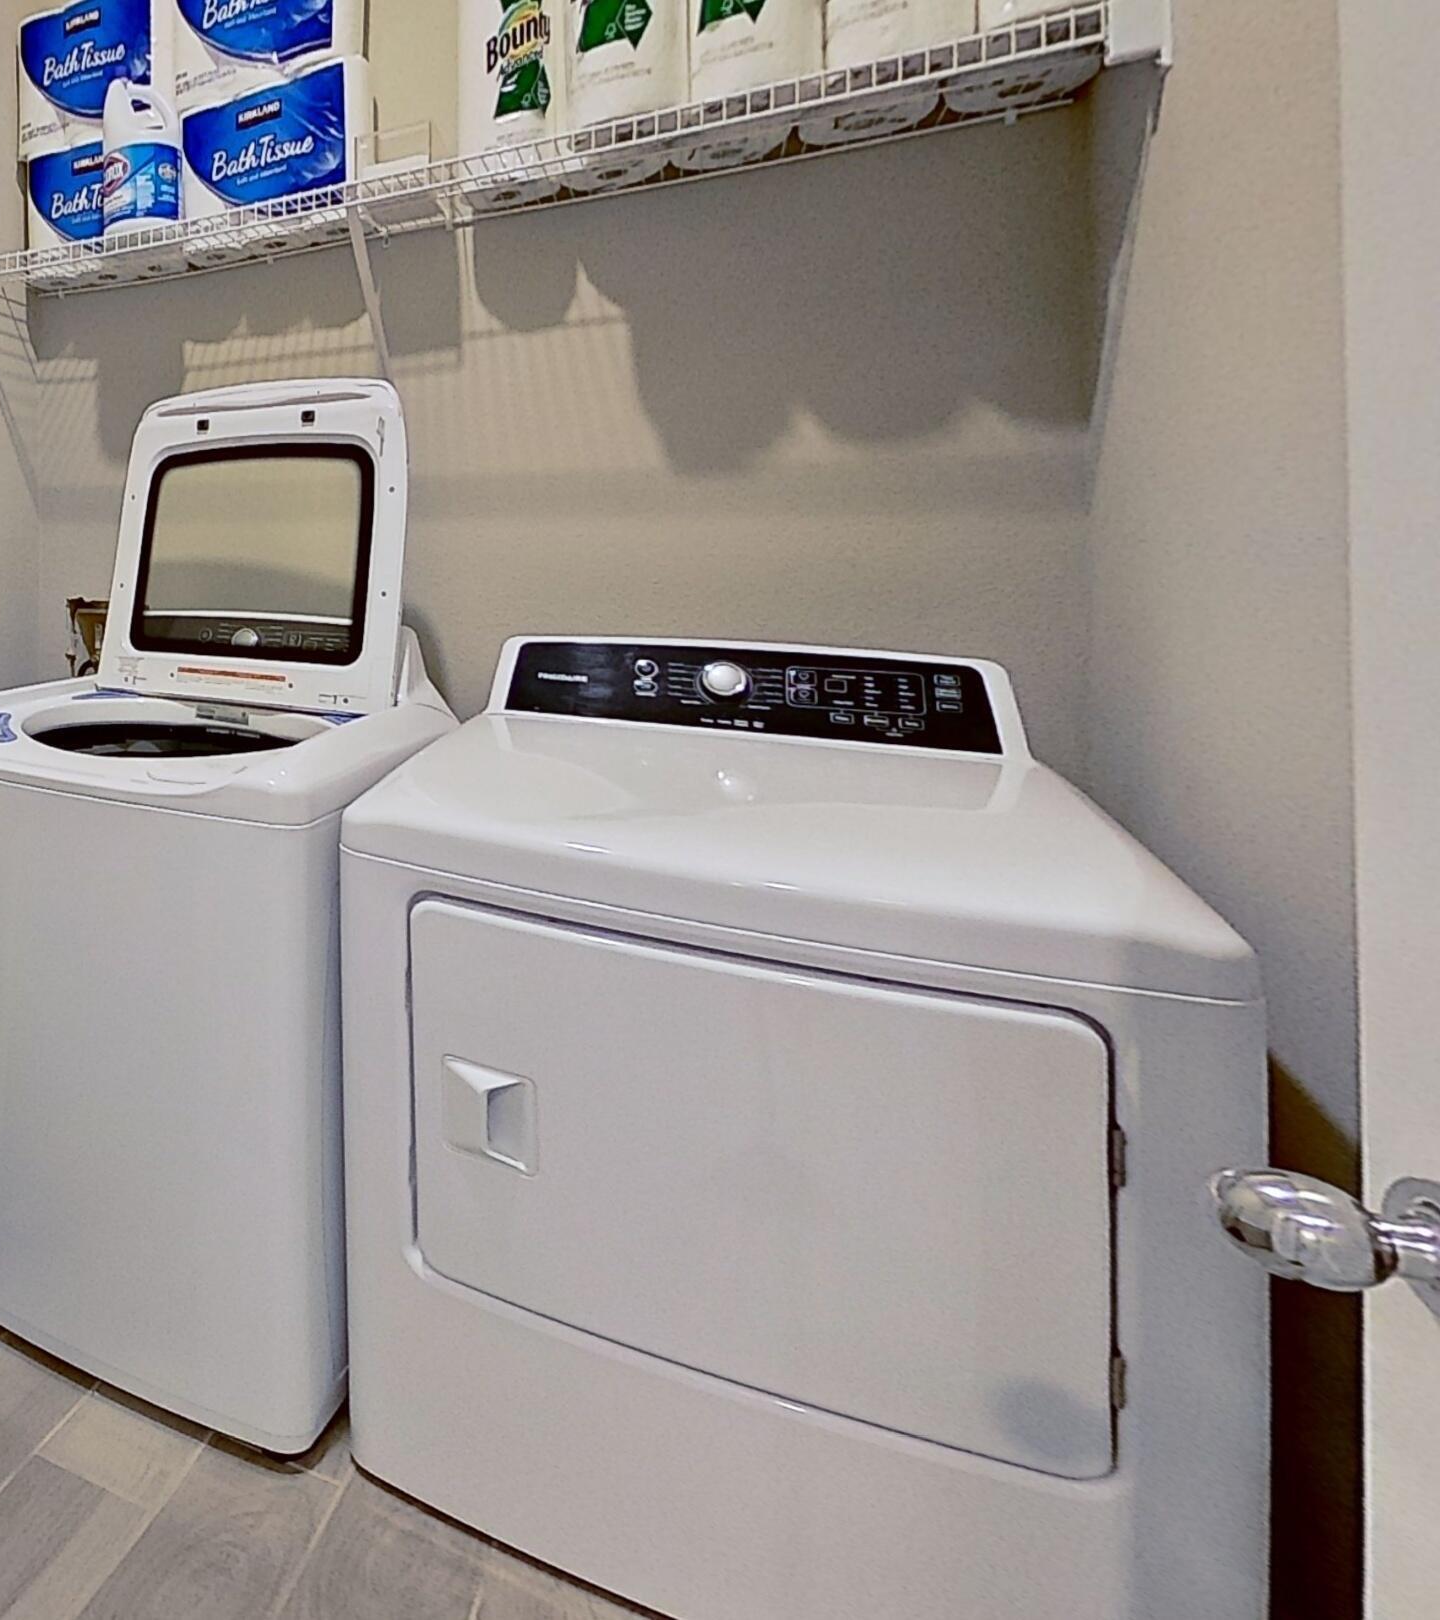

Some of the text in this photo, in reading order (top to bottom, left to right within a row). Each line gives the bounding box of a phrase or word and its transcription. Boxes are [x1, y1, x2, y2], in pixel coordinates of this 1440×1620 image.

[43, 46, 81, 87] Bath
[80, 40, 126, 72] Tissue
[486, 12, 551, 74] Bounty
[237, 101, 281, 124] KIRKLAND
[211, 142, 260, 182] Bath
[259, 133, 315, 167] Tissue
[51, 185, 90, 219] Bath
